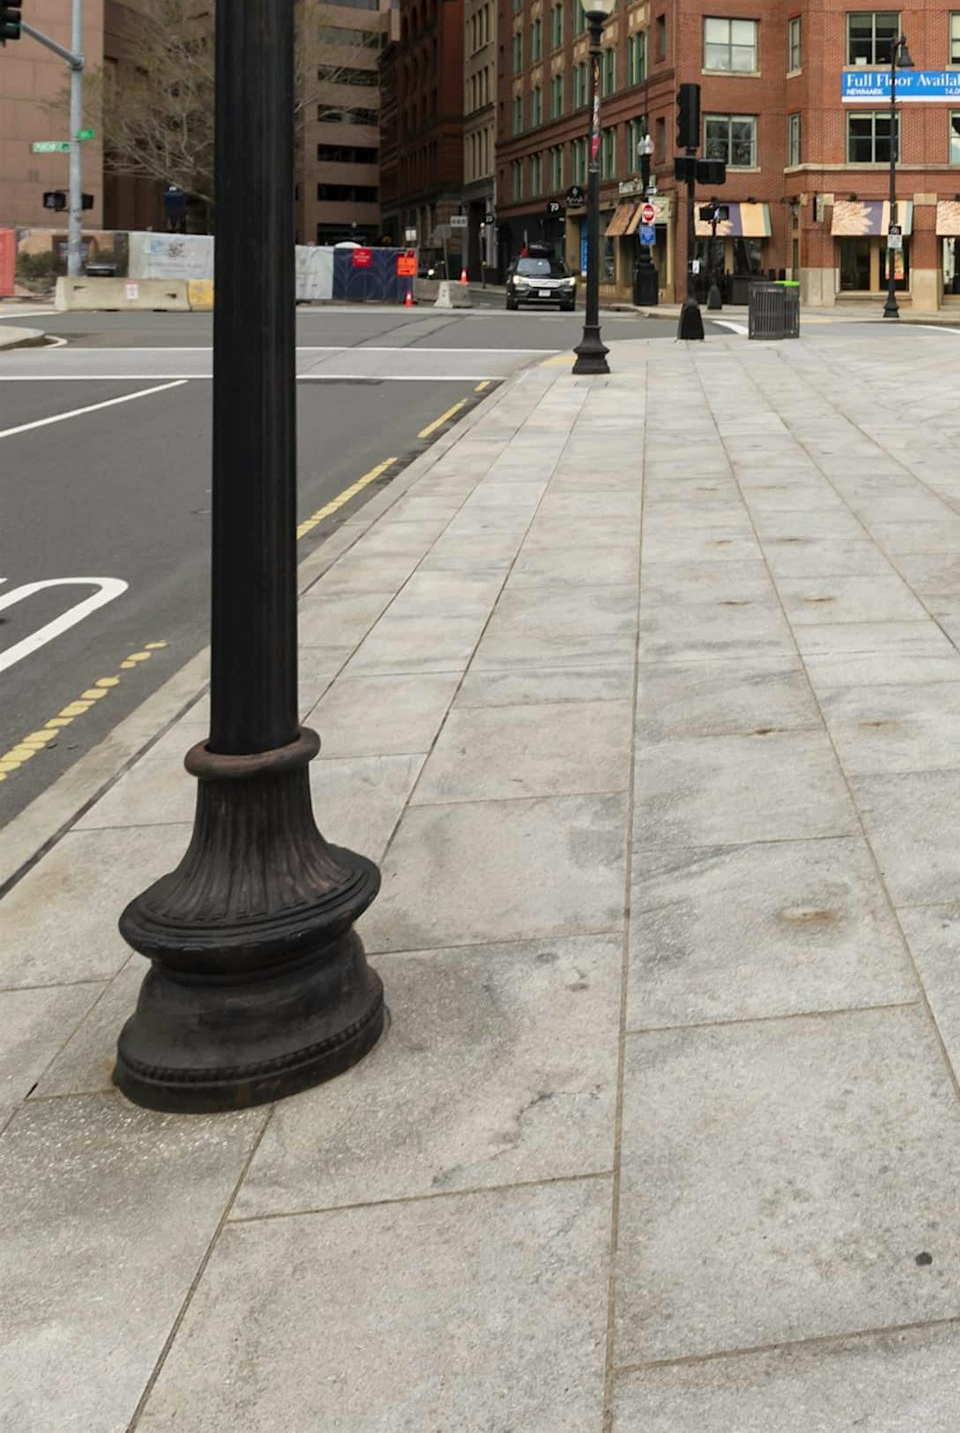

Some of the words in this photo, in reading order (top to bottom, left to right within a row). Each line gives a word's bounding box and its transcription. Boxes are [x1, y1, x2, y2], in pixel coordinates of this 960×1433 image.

[846, 73, 873, 87] Full
[877, 73, 914, 87] Floor
[846, 88, 884, 96] NEWMARK
